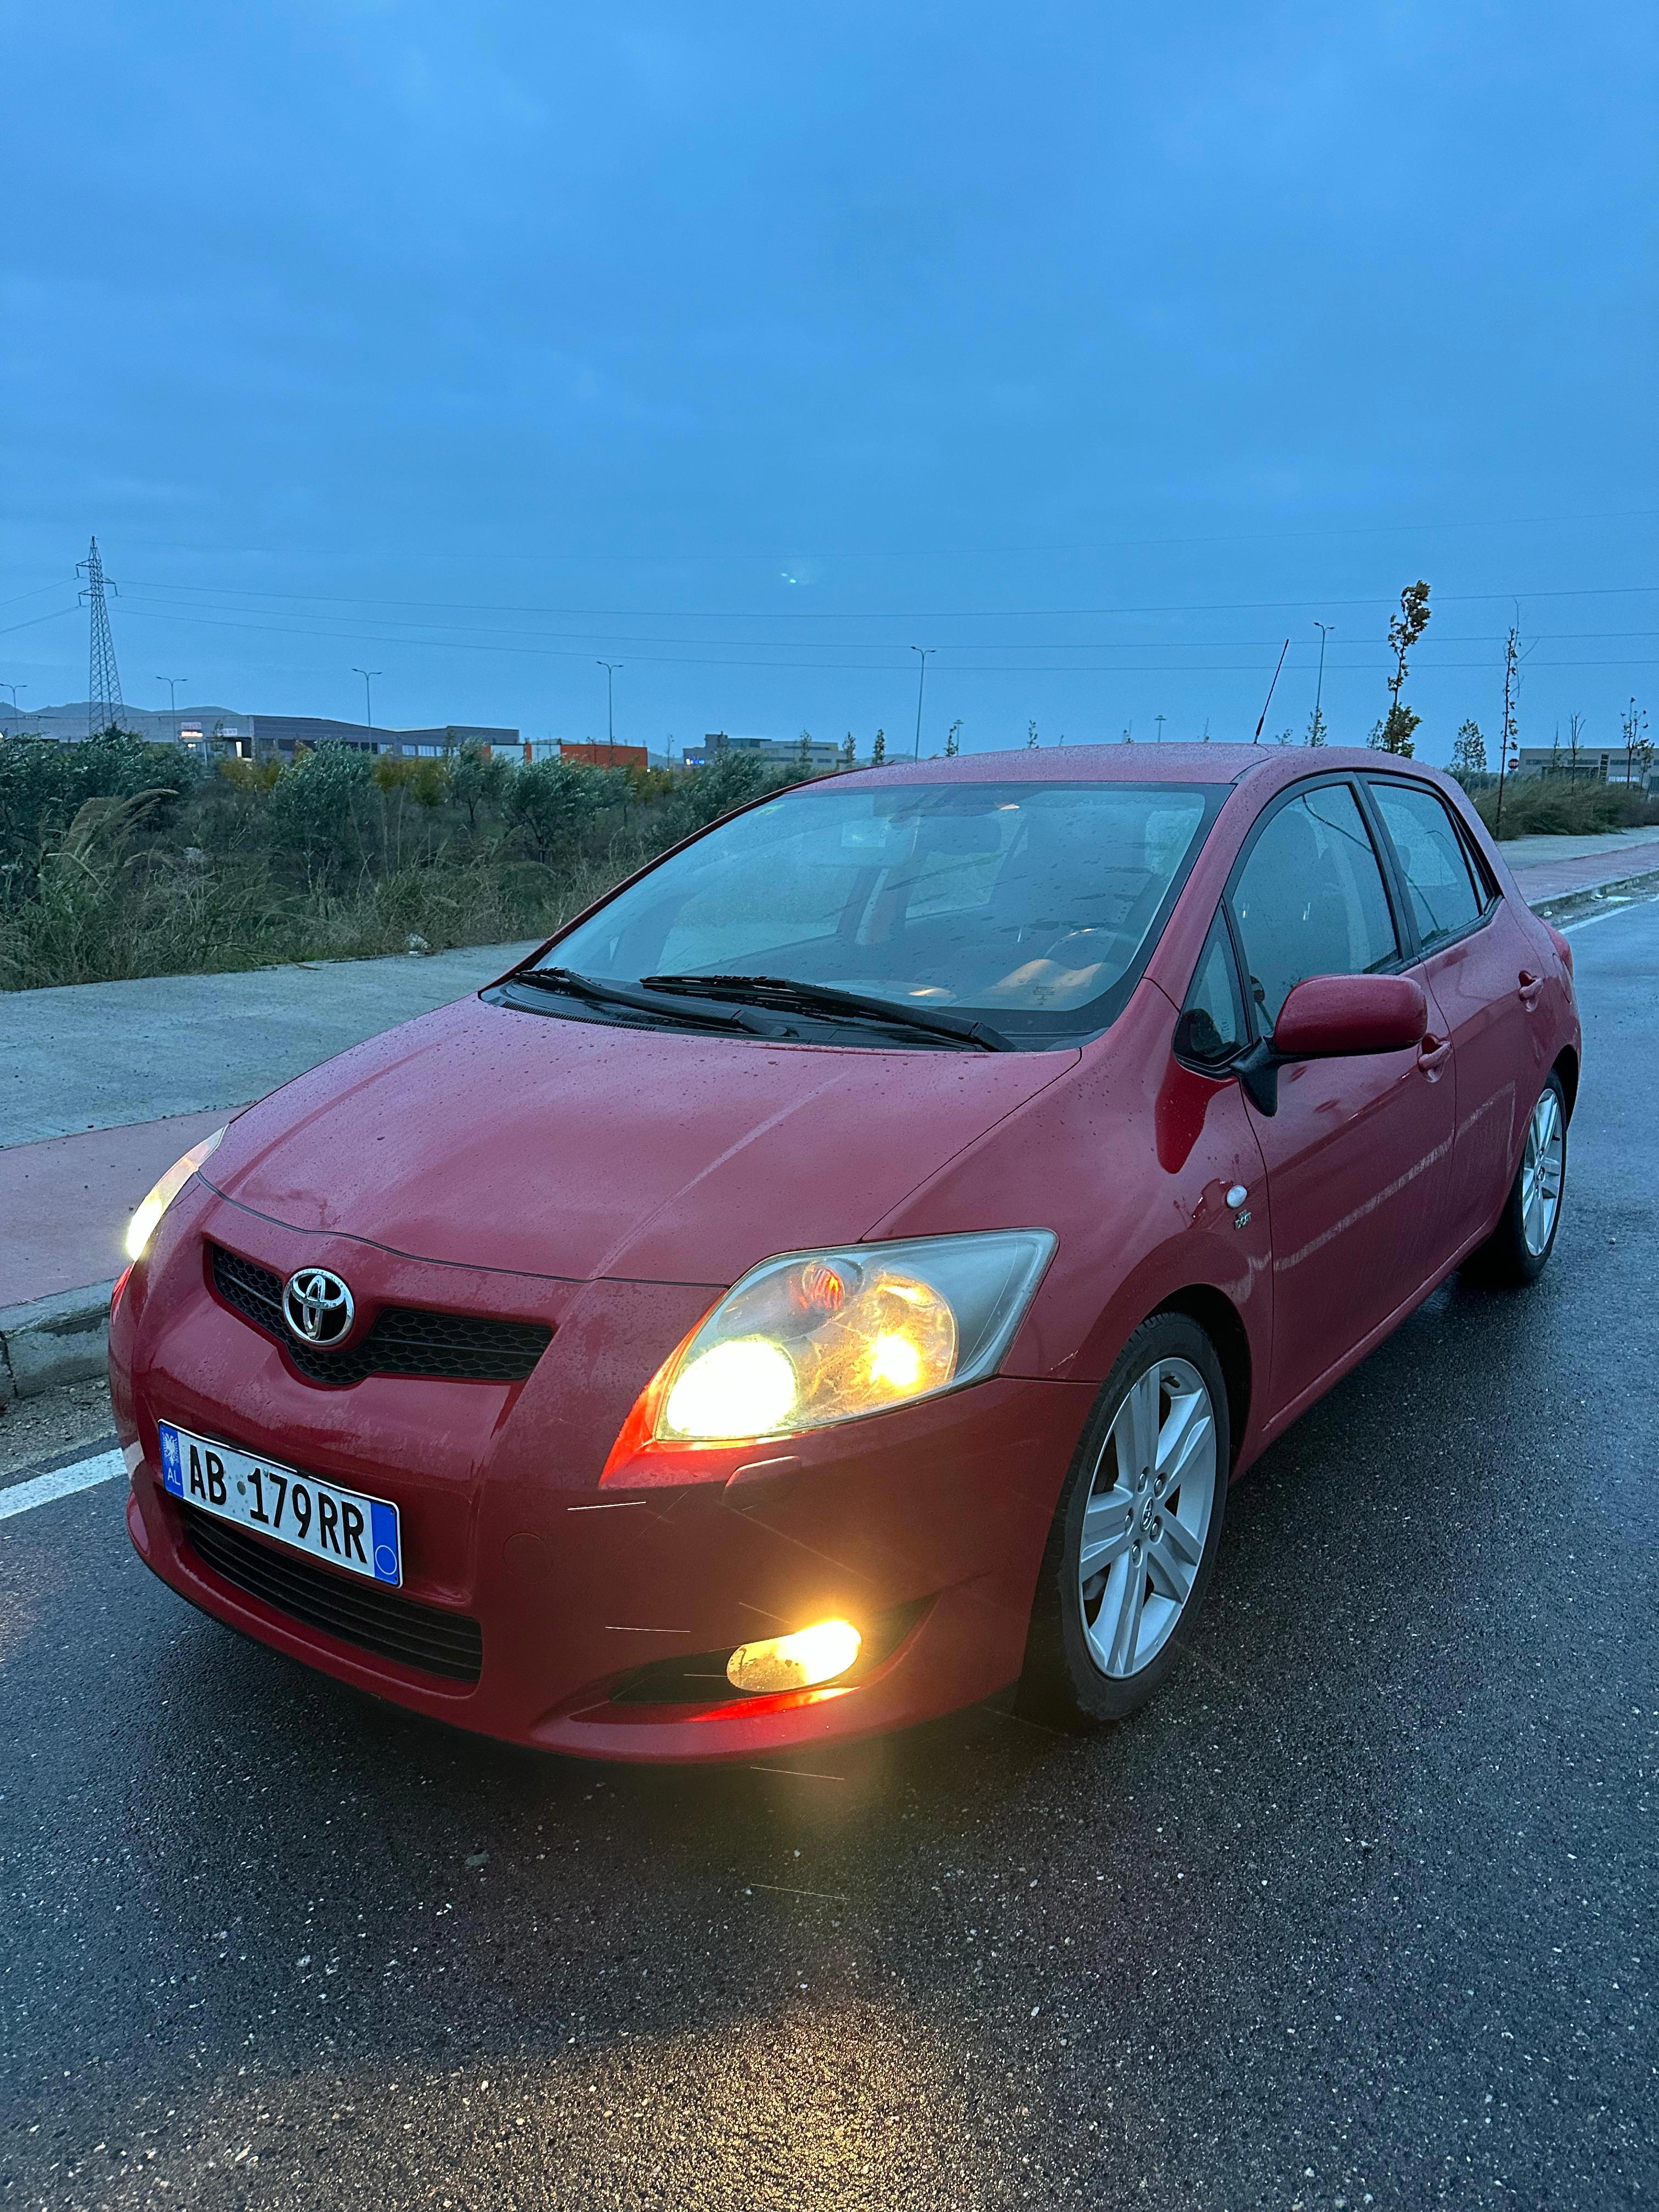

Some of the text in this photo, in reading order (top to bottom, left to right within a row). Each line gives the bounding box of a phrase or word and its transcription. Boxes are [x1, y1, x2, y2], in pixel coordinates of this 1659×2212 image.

[167, 1468, 181, 1486] AL
[190, 1444, 368, 1564] AB 179RR
